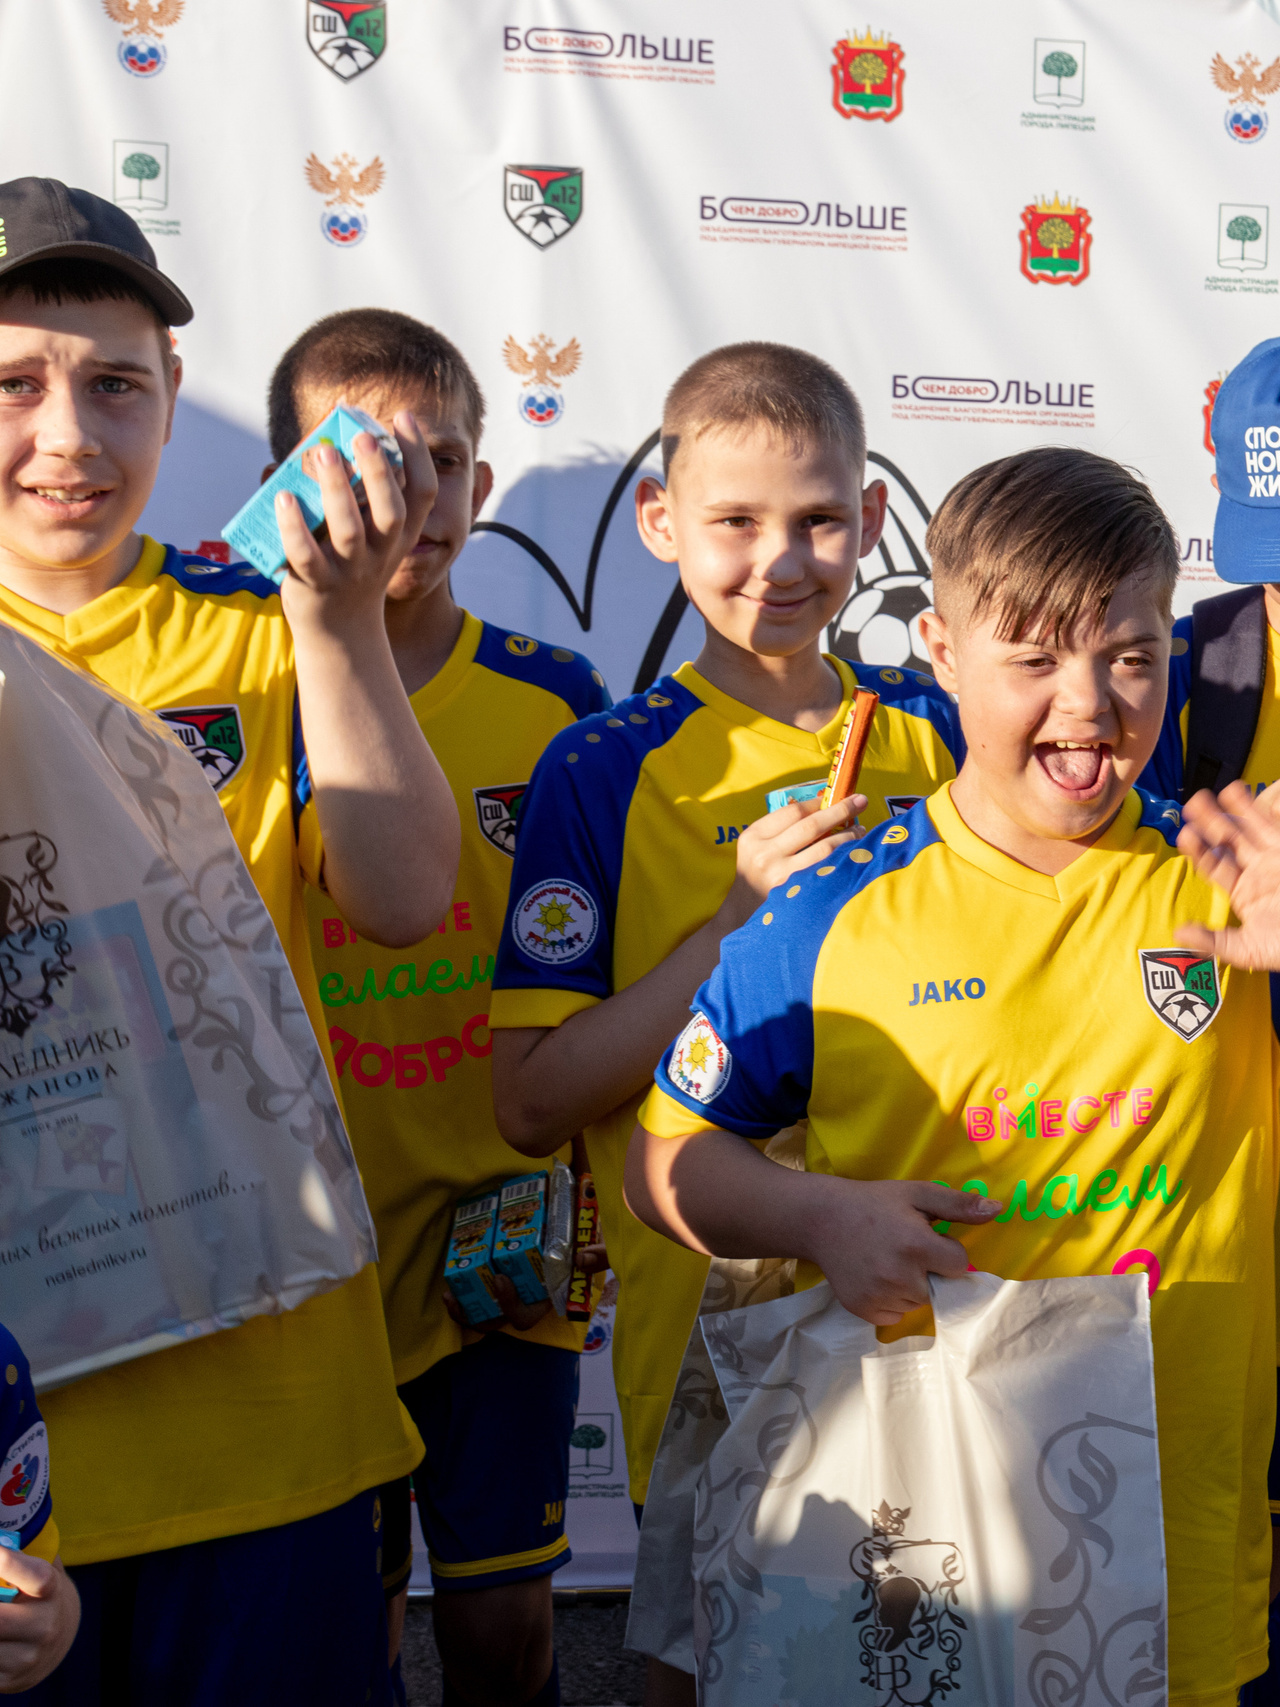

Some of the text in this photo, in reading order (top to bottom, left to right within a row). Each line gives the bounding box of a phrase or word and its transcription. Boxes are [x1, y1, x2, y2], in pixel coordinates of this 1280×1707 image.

[523, 887, 589, 912] СОЛНЕЧНЫЙ МИР
[319, 954, 496, 1008] елаем
[908, 976, 986, 1007] JAKO
[1151, 970, 1176, 990] СШ
[965, 1082, 1154, 1142] ВМЕСТЕ
[930, 1163, 1184, 1234] лаем
[569, 1206, 596, 1305] MEER
